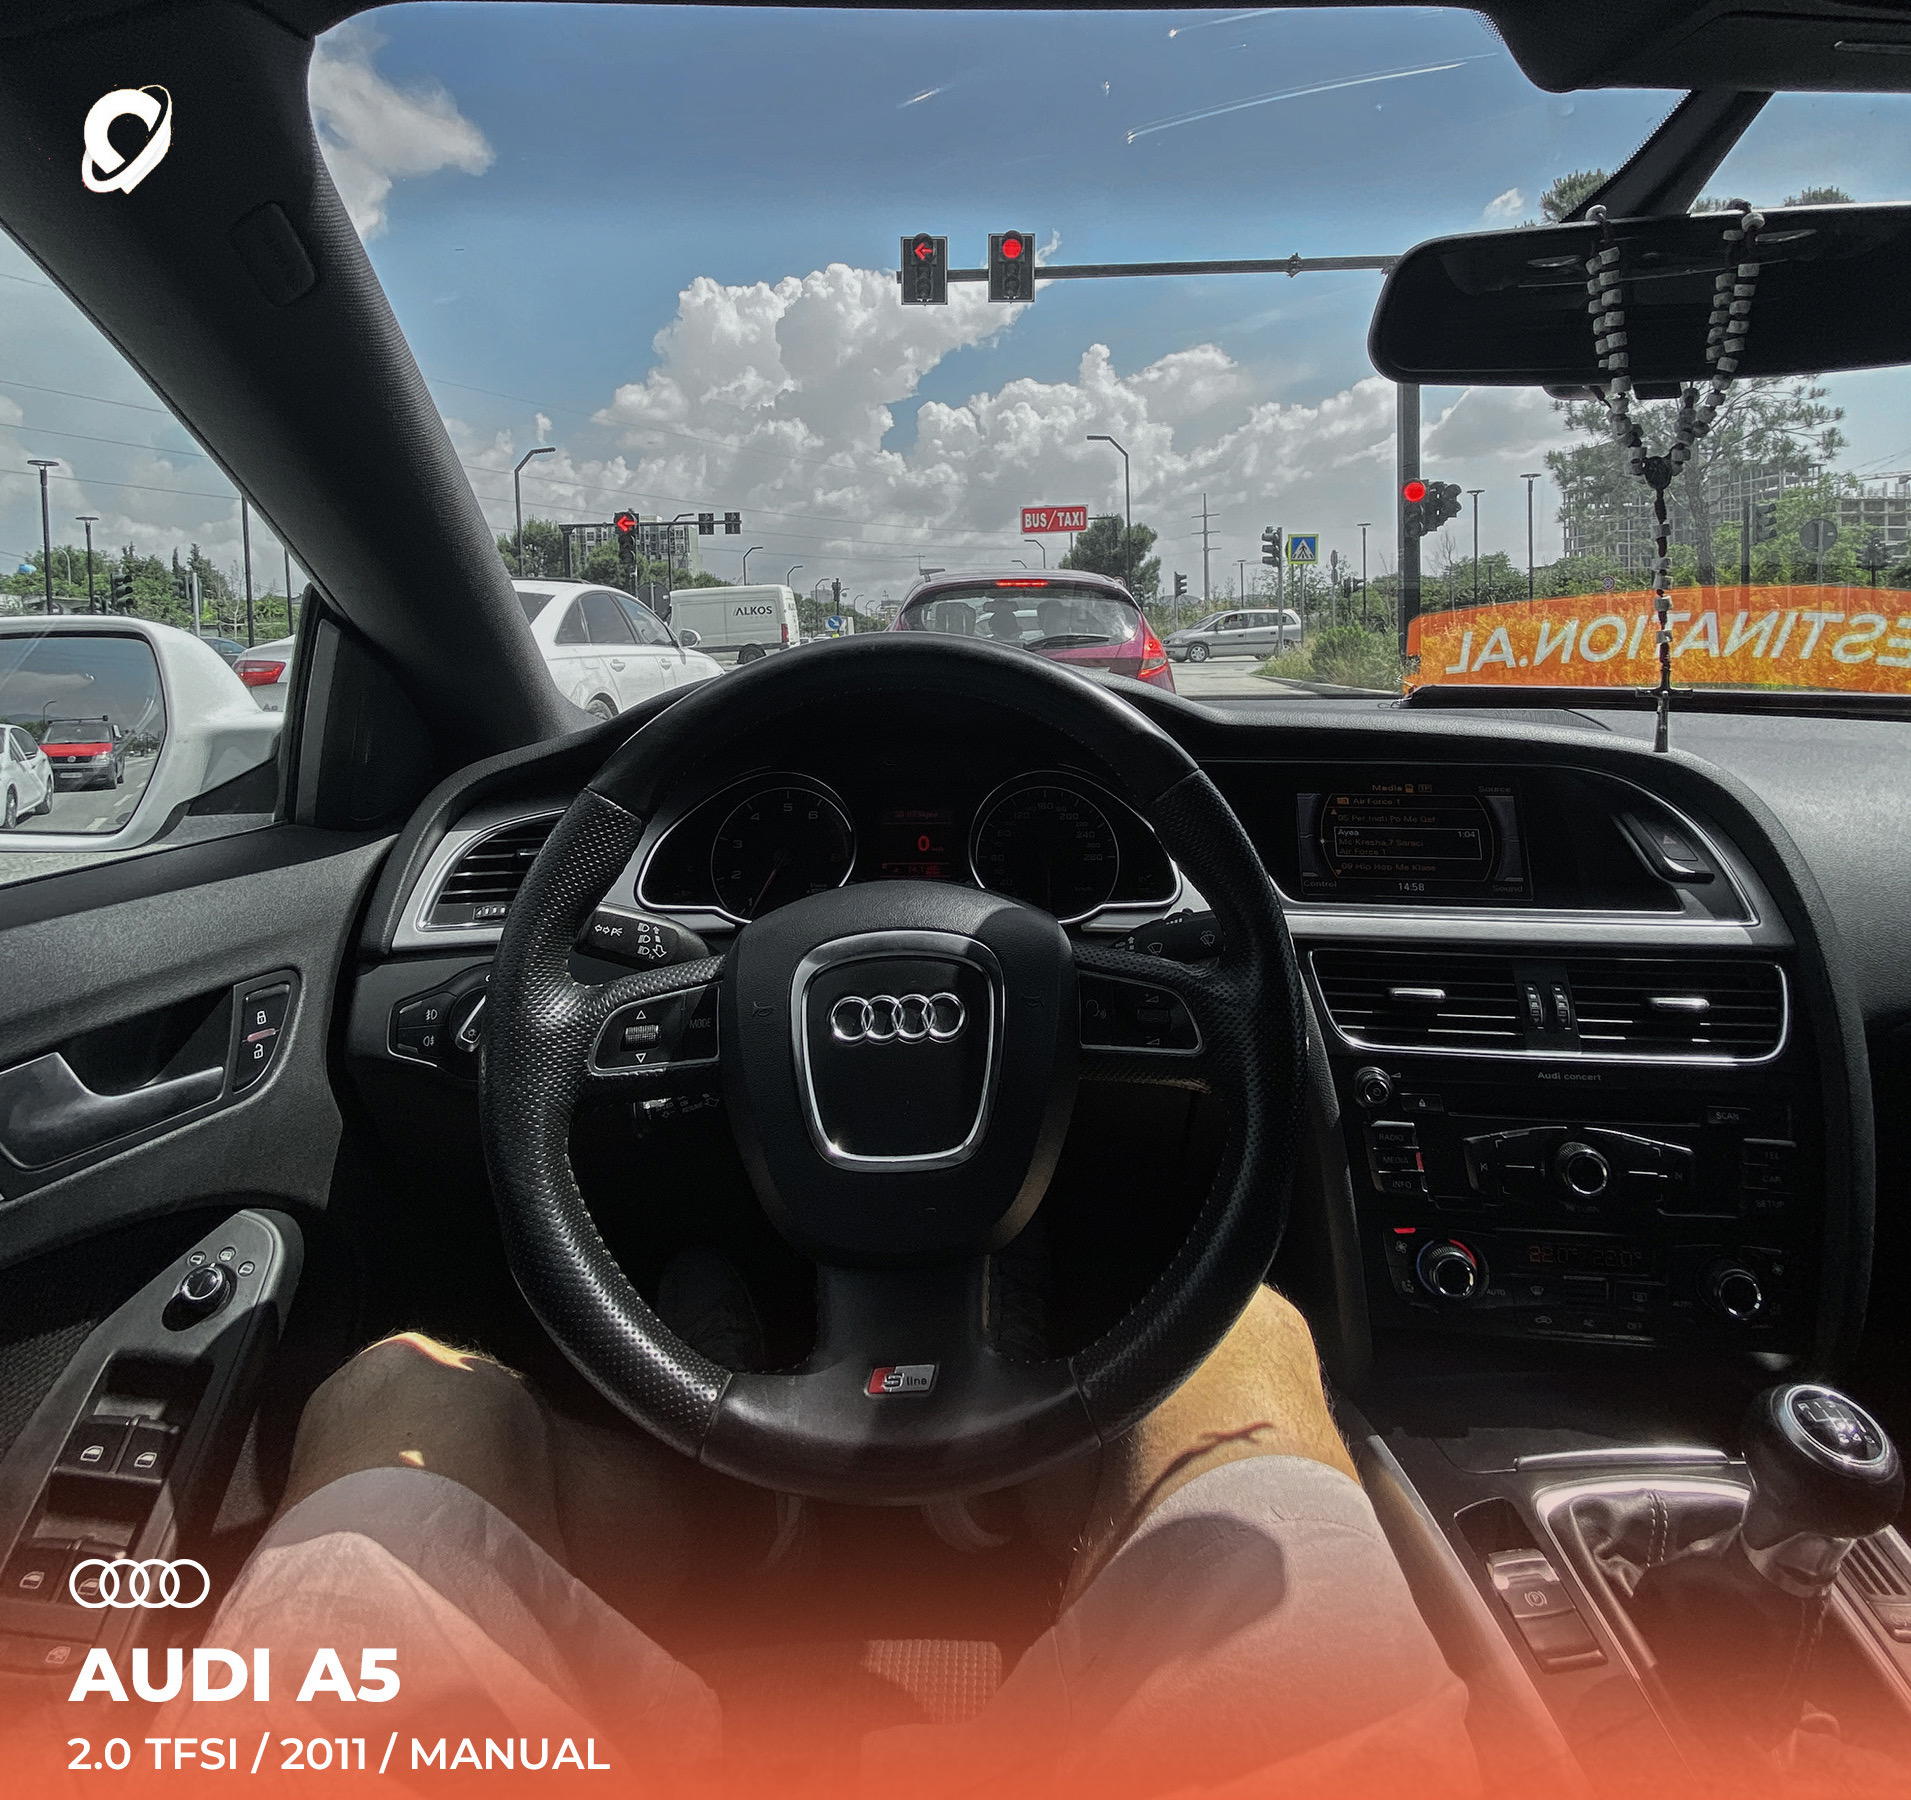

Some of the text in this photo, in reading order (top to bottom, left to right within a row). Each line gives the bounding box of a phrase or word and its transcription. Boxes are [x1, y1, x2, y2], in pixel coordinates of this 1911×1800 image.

[1024, 510, 1084, 530] BUS/TAXI
[735, 605, 773, 617] ALKOS
[1371, 784, 1402, 792] Media
[783, 803, 793, 812] 5
[750, 812, 761, 821] 4
[808, 811, 819, 820] 6
[732, 839, 744, 849] 3
[917, 834, 930, 852] 0
[730, 869, 744, 880] 2
[1397, 882, 1425, 892] 14:58
[1537, 1072, 1601, 1081] Audi concert
[1715, 1111, 1740, 1120] SCAN
[906, 1376, 927, 1386] line
